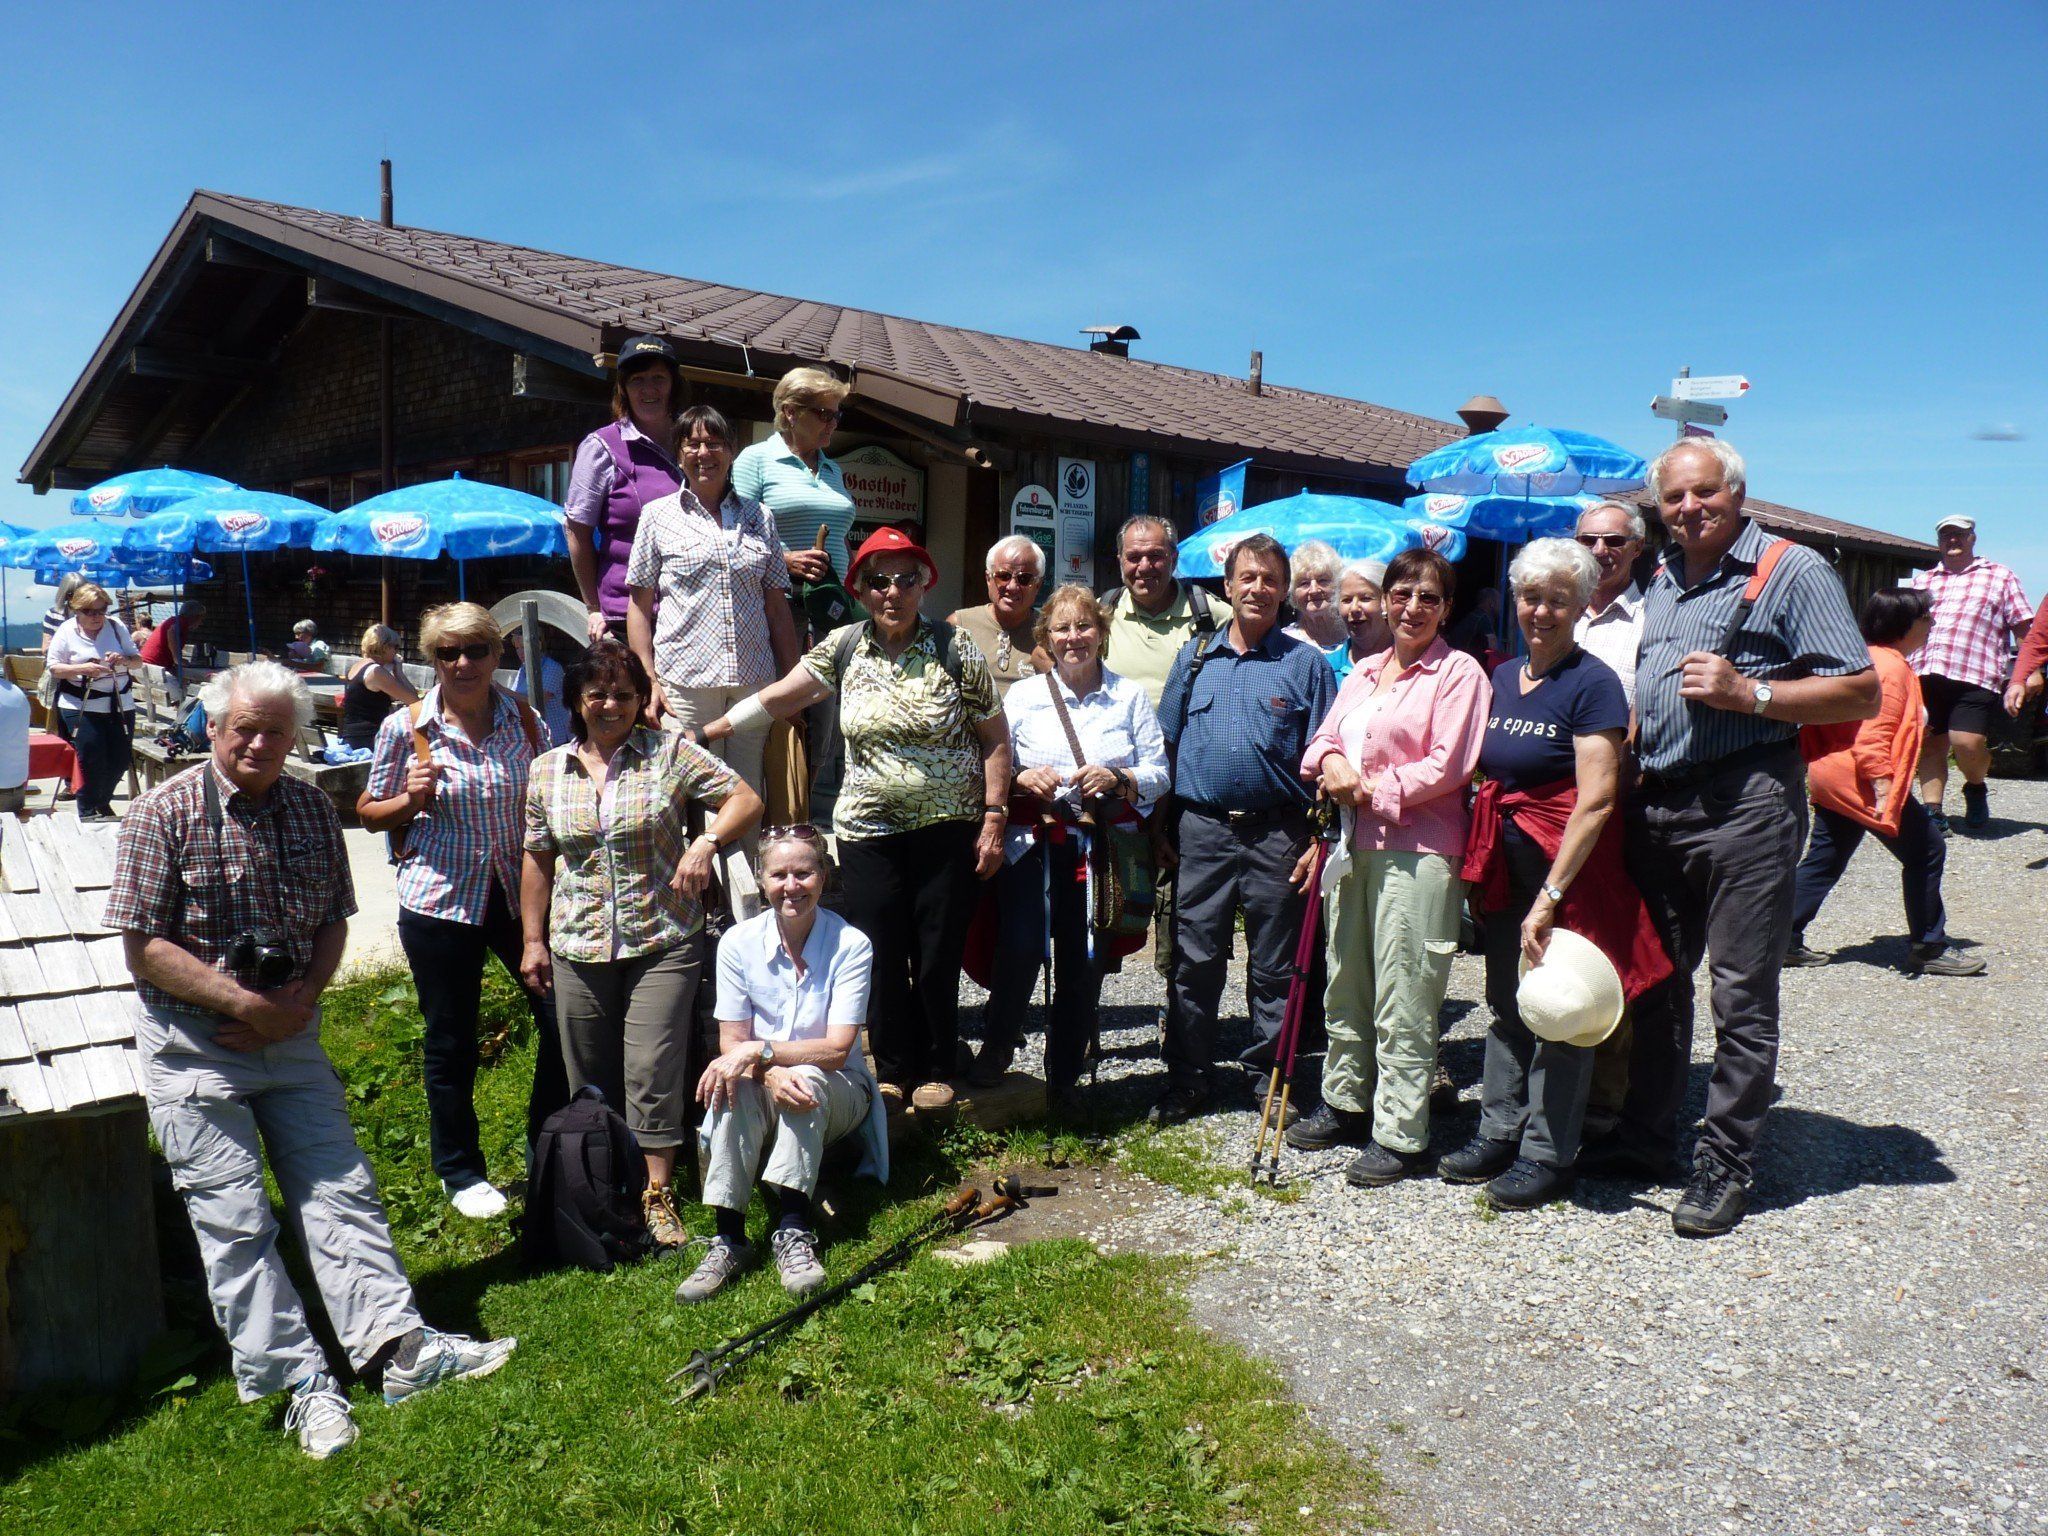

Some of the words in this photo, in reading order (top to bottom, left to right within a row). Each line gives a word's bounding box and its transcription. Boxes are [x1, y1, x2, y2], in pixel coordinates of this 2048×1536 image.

[842, 472, 907, 497] Gasthof
[876, 496, 918, 512] Niedere
[1503, 716, 1557, 738] eppas
